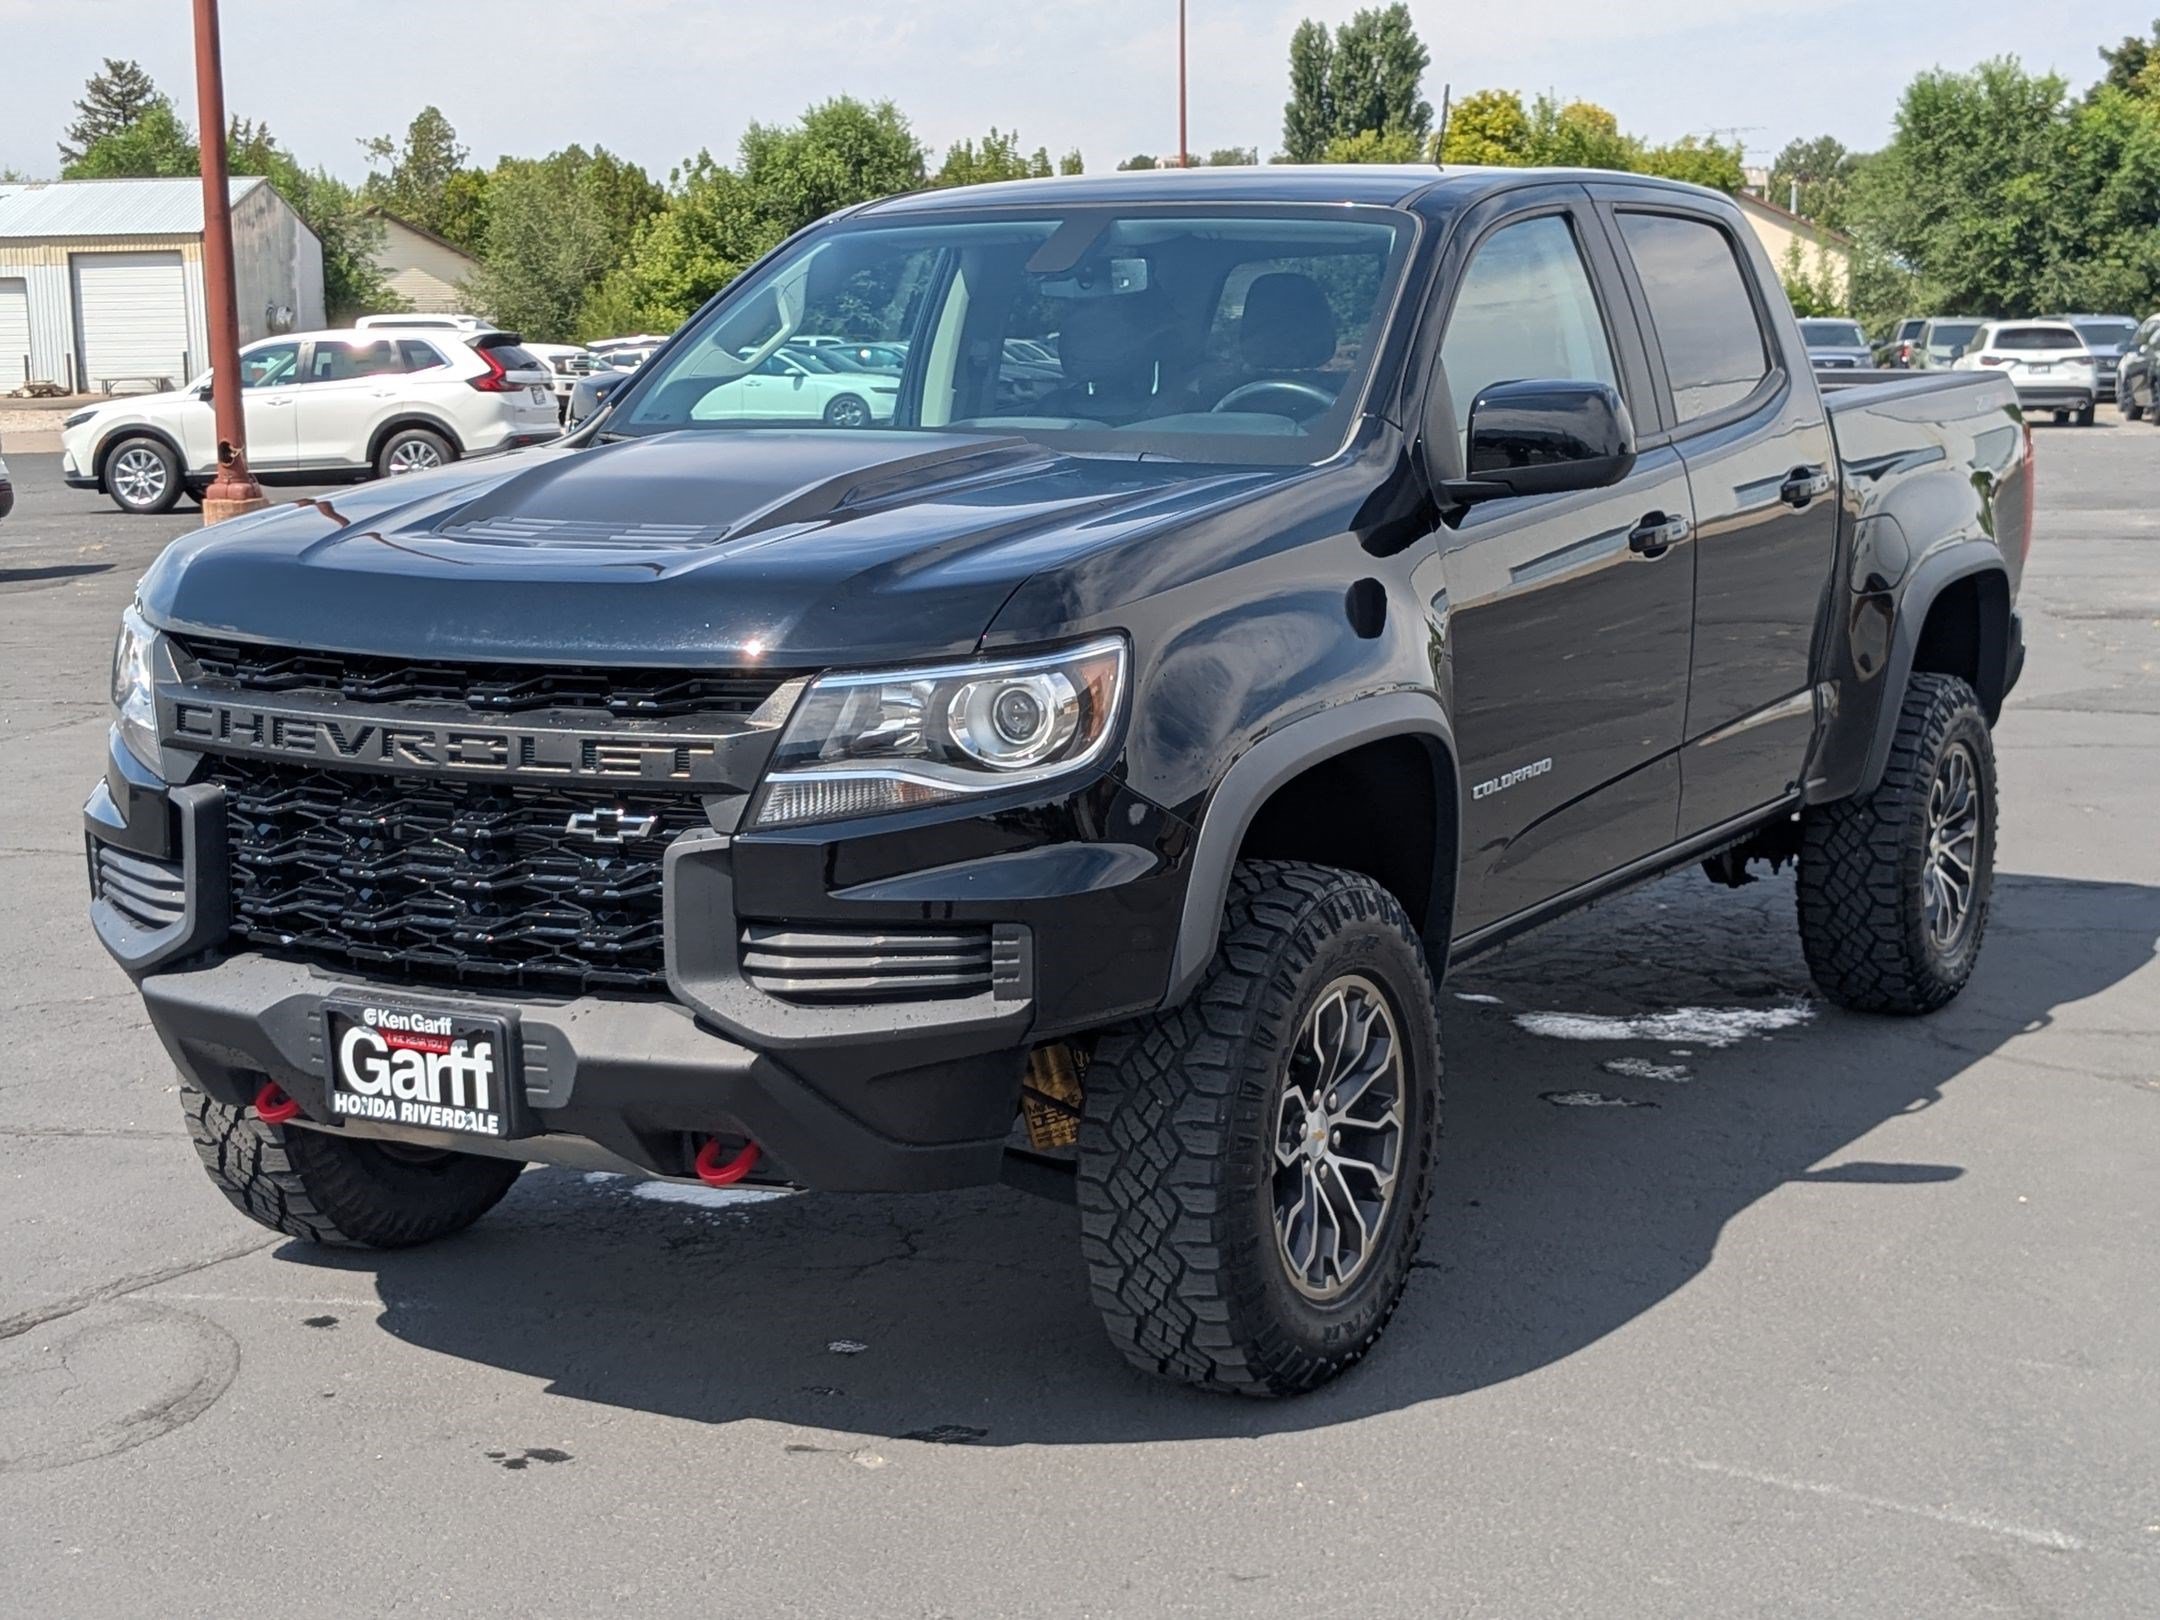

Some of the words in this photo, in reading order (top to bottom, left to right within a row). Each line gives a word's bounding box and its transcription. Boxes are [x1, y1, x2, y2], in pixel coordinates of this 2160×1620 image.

[175, 702, 715, 779] CHEVROLET
[1472, 757, 1553, 800] COLORADO
[378, 1008, 409, 1031] Ken
[411, 1013, 452, 1036] Garff
[340, 1025, 494, 1110] Garff
[334, 1093, 397, 1120] HONDA
[401, 1102, 499, 1135] RIVERDALE
